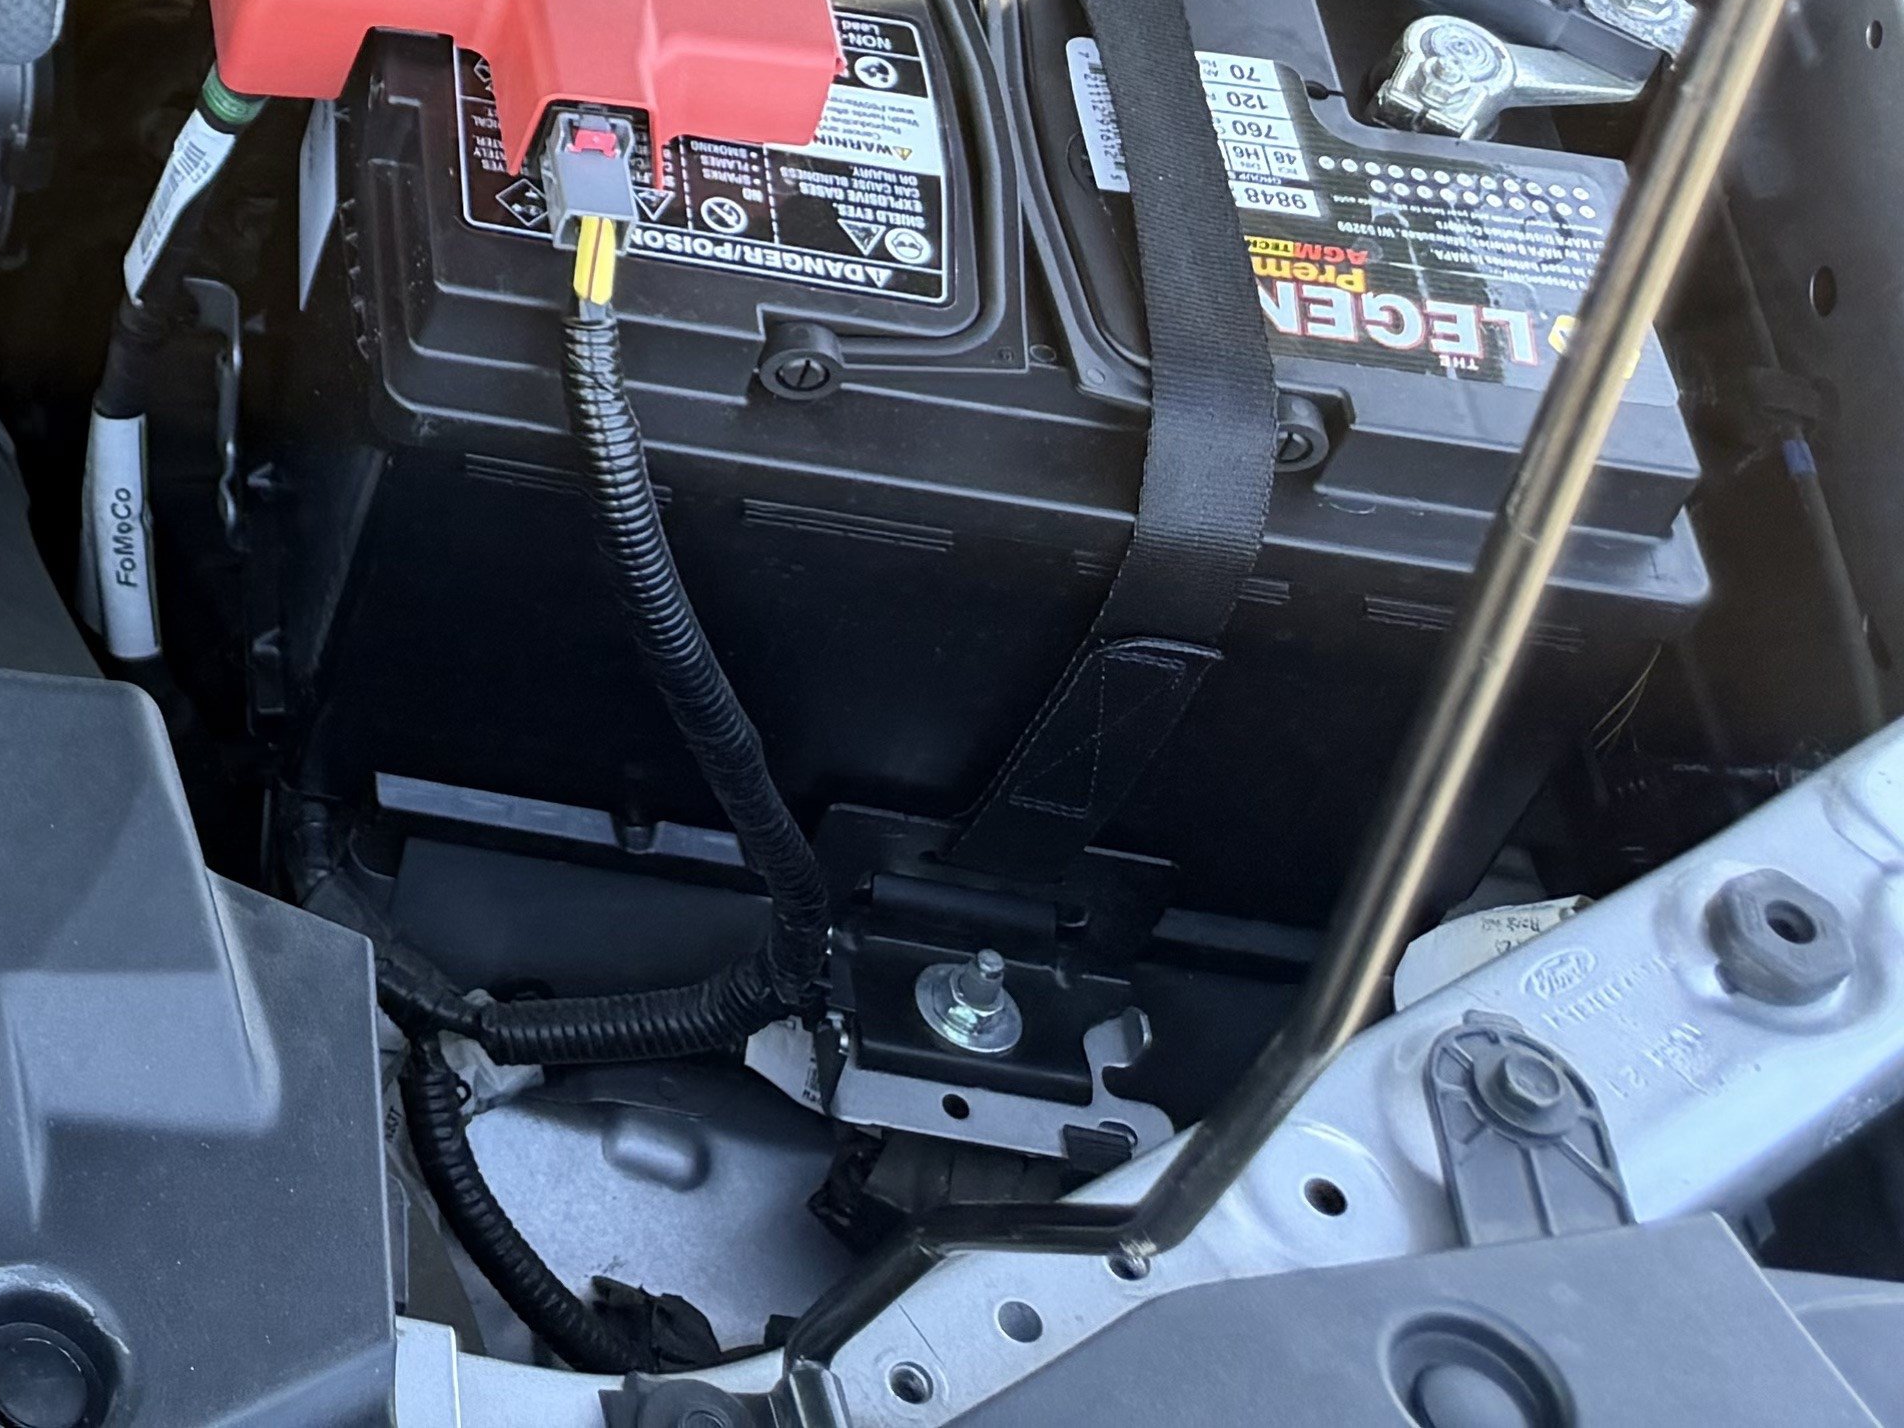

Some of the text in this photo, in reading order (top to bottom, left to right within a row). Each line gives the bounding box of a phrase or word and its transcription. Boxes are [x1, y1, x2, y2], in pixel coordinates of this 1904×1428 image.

[1229, 64, 1260, 82] 70
[1226, 91, 1269, 110] 120
[1232, 120, 1279, 140] 760
[690, 140, 748, 158] SMOKING
[1232, 145, 1259, 160] H6
[700, 155, 750, 172] FLAMES
[701, 168, 752, 185] SPARKS
[742, 187, 764, 203] NO
[851, 178, 891, 194] CAUSE
[894, 185, 920, 198] CAN
[798, 181, 923, 213] EXPLOSIVE GASES
[1244, 187, 1307, 210] 9848
[874, 207, 926, 229] SHIELD
[1293, 241, 1368, 265] AGM
[1439, 353, 1480, 372] THE
[110, 487, 138, 588] FoMoCo
